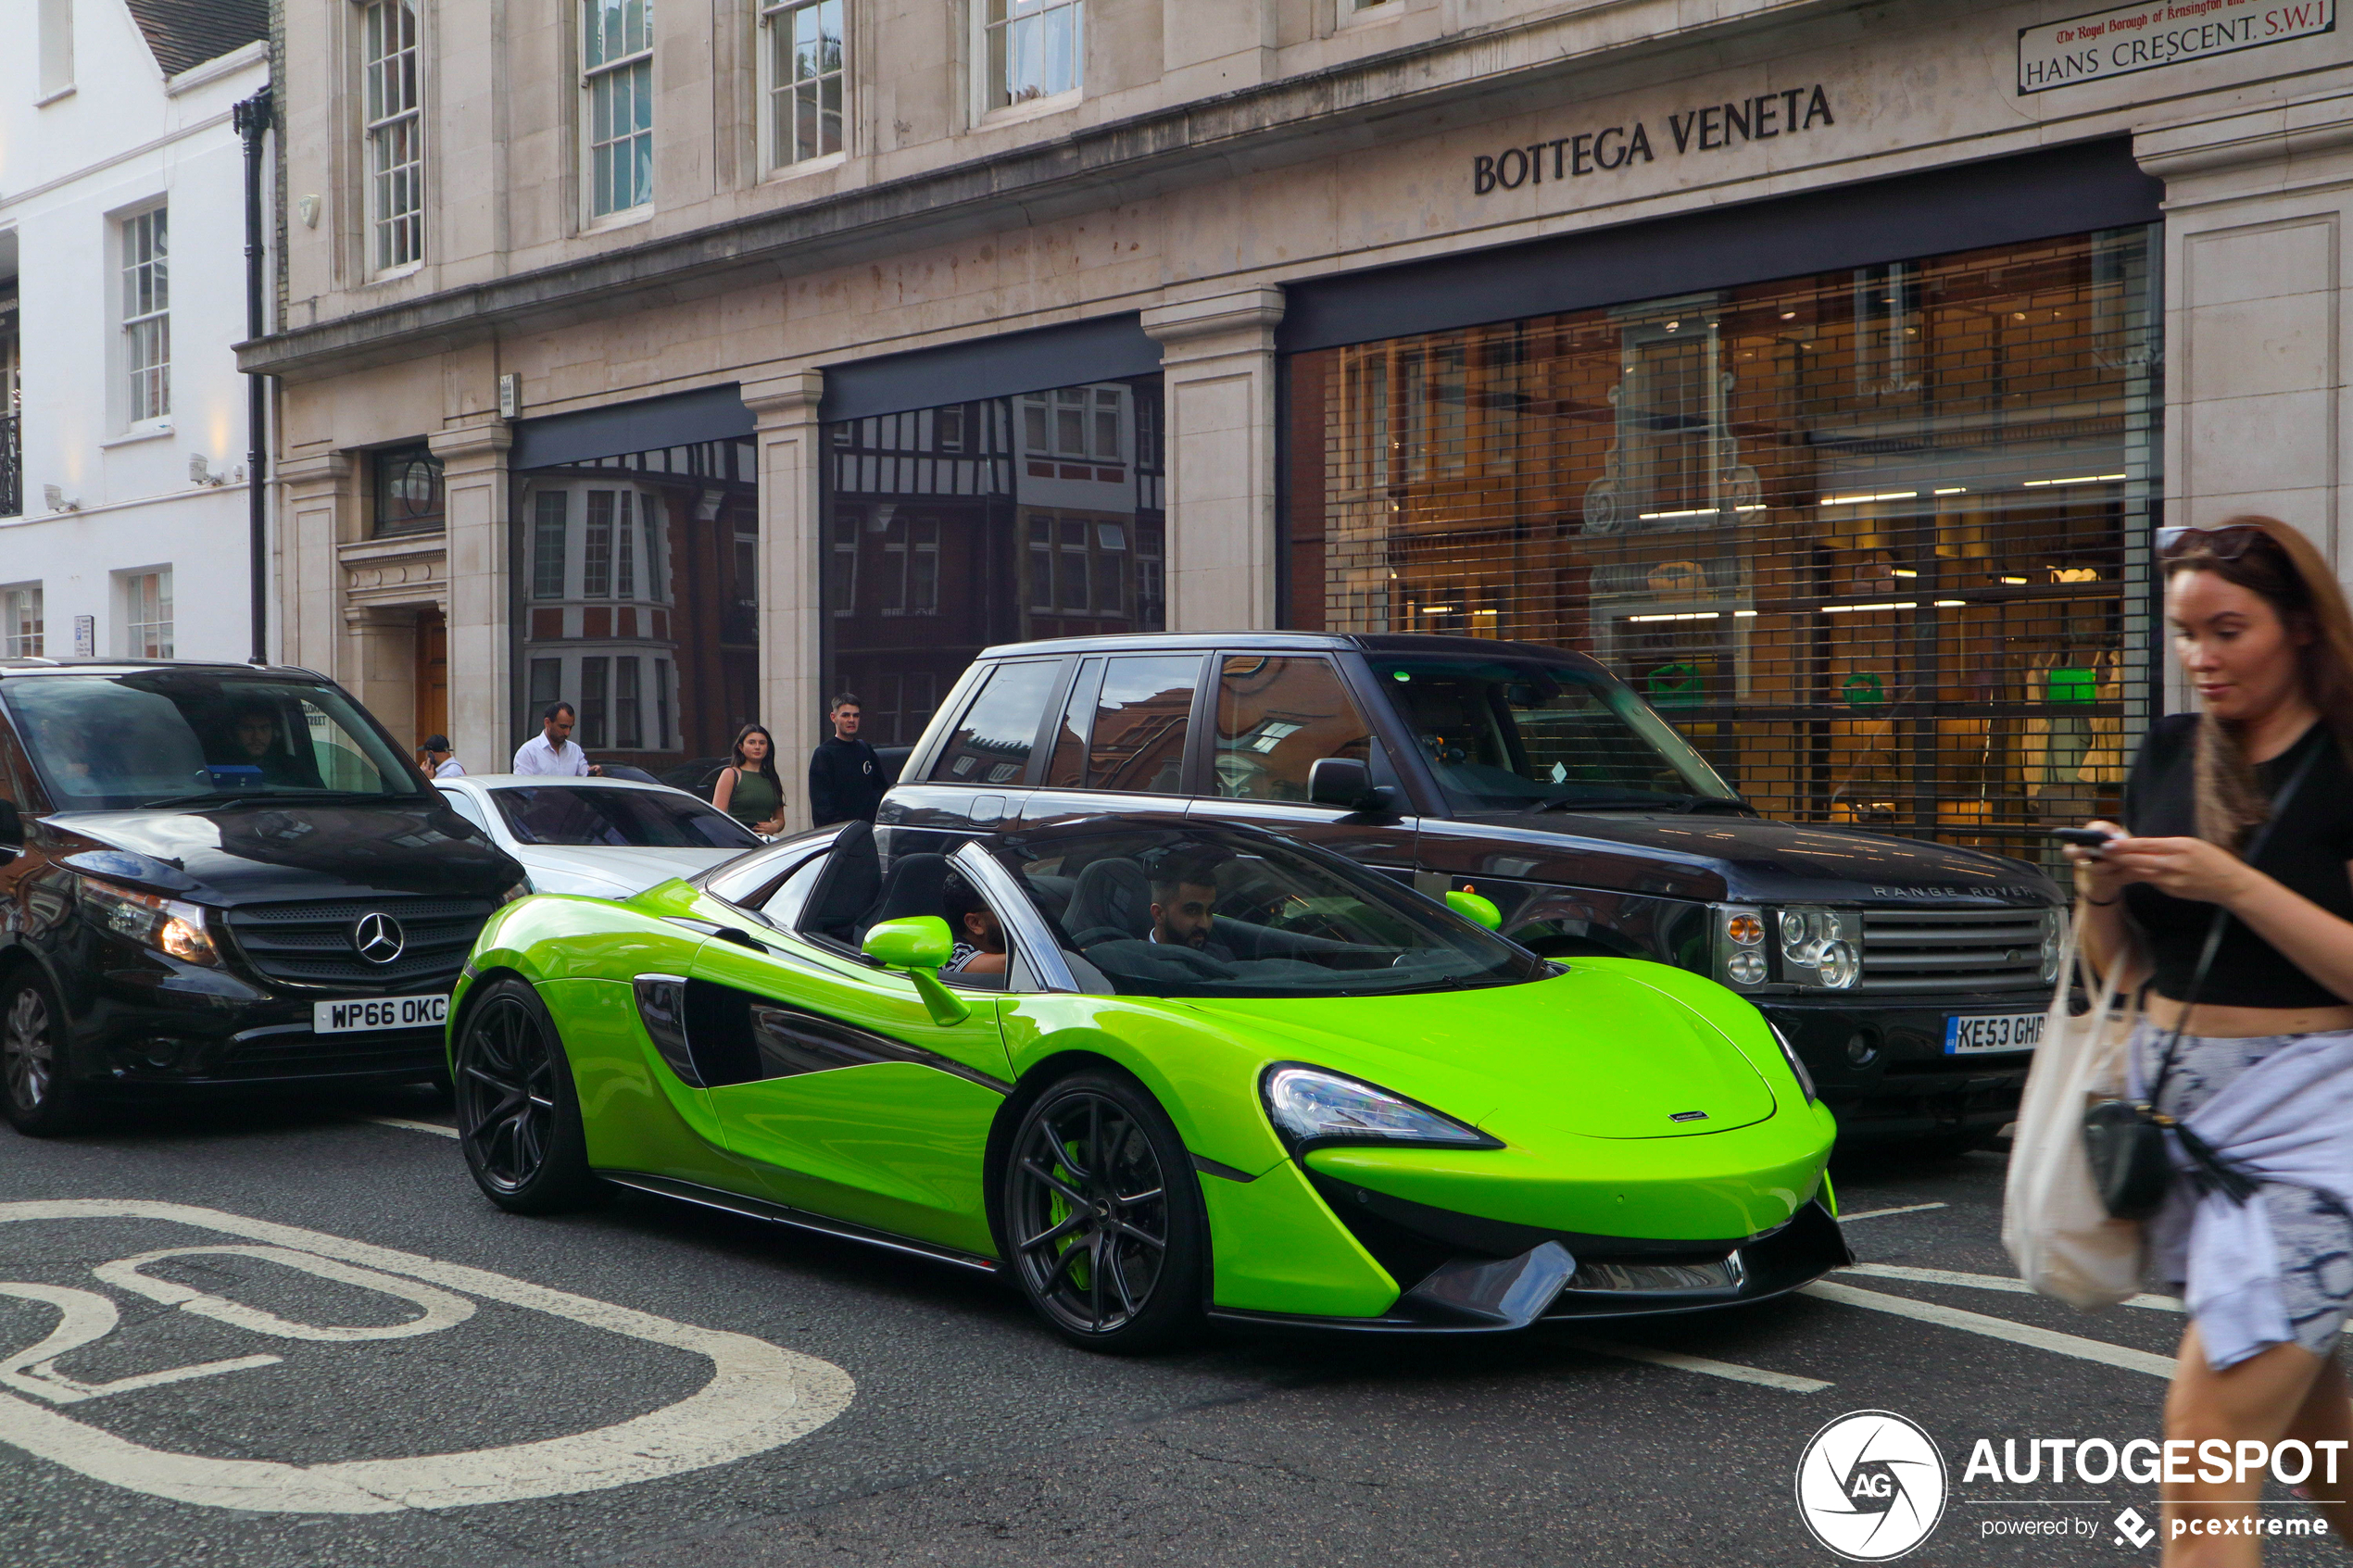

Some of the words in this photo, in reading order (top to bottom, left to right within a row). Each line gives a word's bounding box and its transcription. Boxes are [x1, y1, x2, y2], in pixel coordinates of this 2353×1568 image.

[2057, 31, 2075, 44] The
[2077, 23, 2105, 40] Royal
[2108, 14, 2148, 31] Borough
[2152, 9, 2163, 23] of
[2167, 0, 2222, 20] Kensington
[2026, 48, 2099, 86] HANS
[1473, 122, 1655, 194] BOTTEGA
[1668, 83, 1835, 155] VENETA
[1871, 886, 1957, 897] RANGE
[1969, 886, 2036, 898] ROVER
[332, 1001, 395, 1029] WP66
[402, 997, 446, 1023] OKC
[1958, 1018, 2010, 1047] KE53
